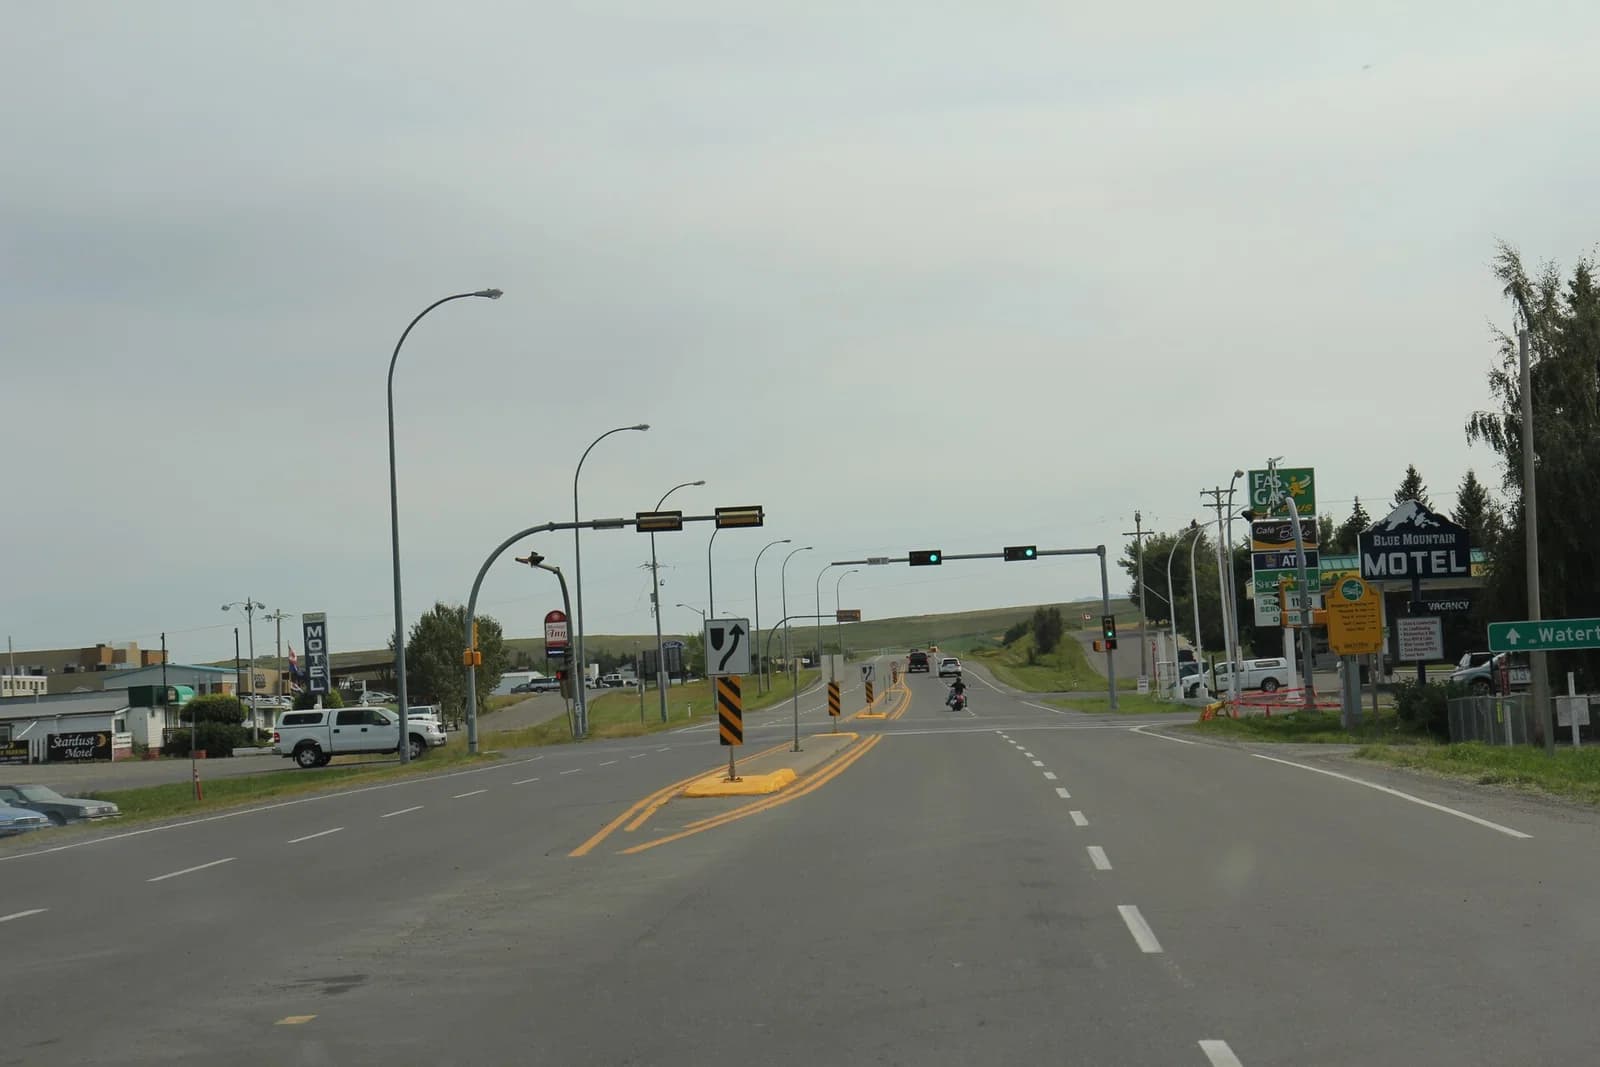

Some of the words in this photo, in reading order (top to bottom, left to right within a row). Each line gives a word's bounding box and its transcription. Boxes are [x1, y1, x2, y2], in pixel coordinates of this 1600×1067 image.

[1254, 473, 1282, 489] FAS
[1254, 489, 1287, 505] GAS
[1280, 504, 1312, 513] PUS
[1364, 551, 1467, 576] MOTEL
[1427, 601, 1470, 611] VACANCY
[1538, 626, 1600, 642] Watert
[306, 626, 325, 691] MOTEL
[51, 735, 95, 749] Stardust
[65, 746, 95, 758] Motel
